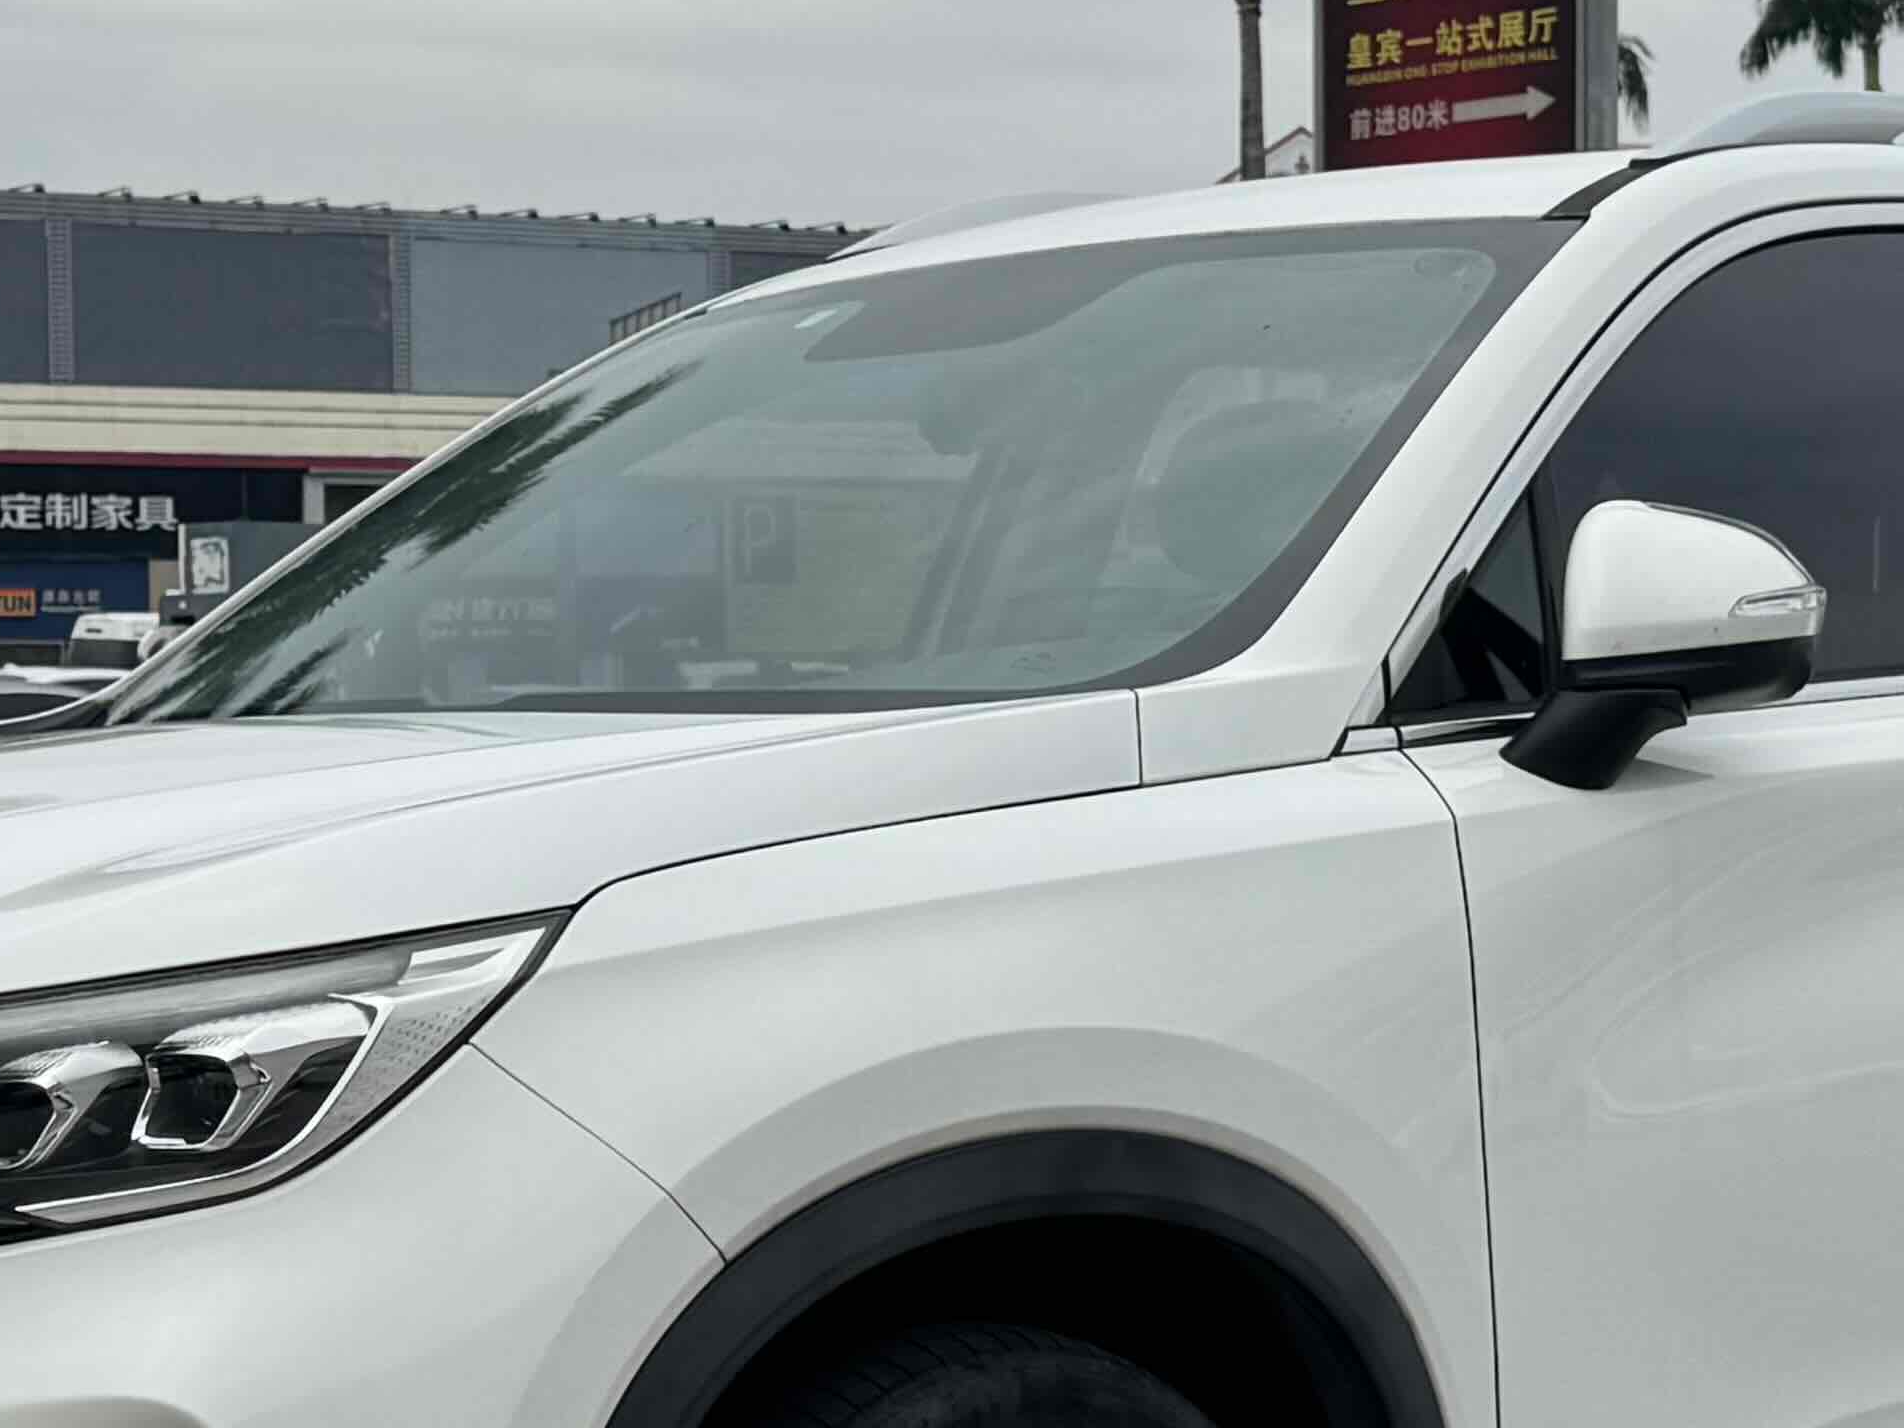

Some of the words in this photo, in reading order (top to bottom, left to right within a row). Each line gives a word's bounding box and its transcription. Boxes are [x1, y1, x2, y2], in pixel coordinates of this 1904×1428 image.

[1348, 7, 1558, 68] 皇宾一站式展厅
[1348, 97, 1450, 141] 前进80米
